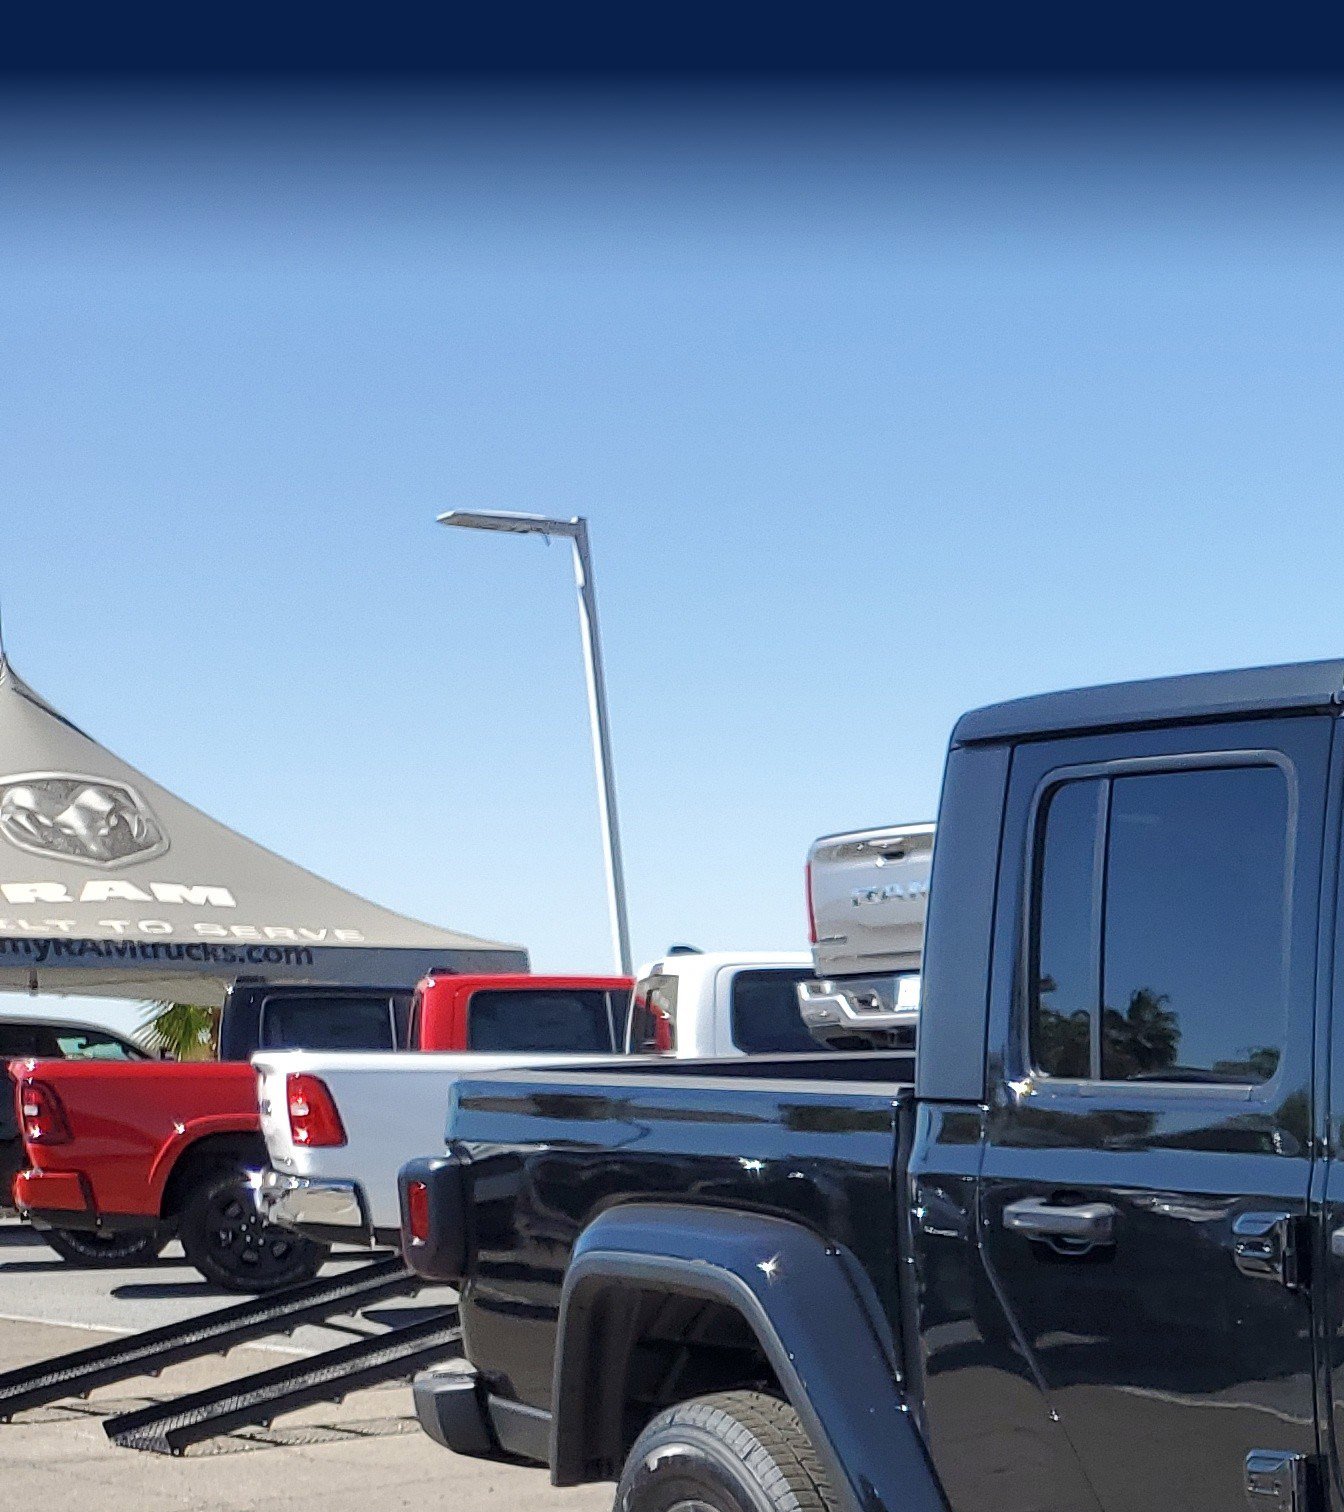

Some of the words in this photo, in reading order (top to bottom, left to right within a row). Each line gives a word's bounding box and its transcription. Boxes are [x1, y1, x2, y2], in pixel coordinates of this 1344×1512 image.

[1, 880, 236, 908] RAM
[100, 919, 173, 935] TO
[193, 922, 365, 941] SERVE
